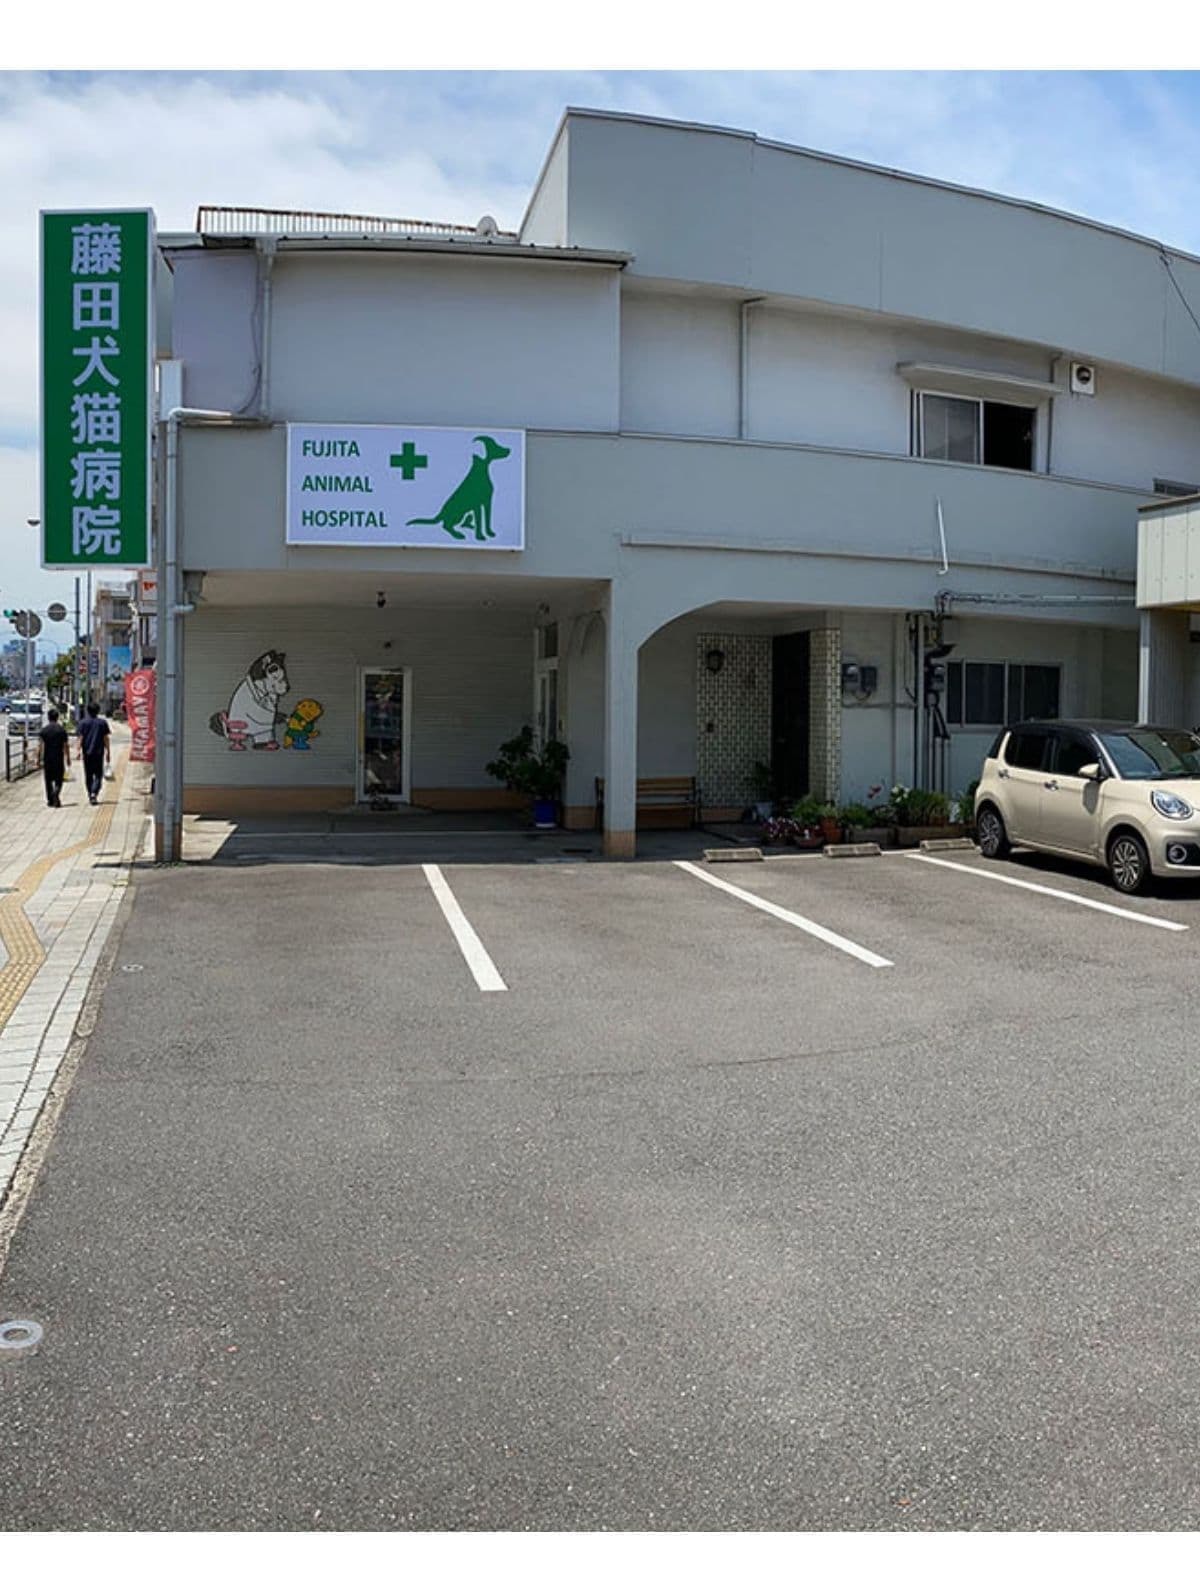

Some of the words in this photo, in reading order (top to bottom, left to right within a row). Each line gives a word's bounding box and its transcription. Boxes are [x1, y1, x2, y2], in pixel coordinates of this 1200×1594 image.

[71, 223, 122, 556] 藤田犬猫病院
[302, 440, 360, 457] FUJITA
[302, 475, 373, 492] ANIMAL
[302, 510, 388, 527] HOSPITAL
